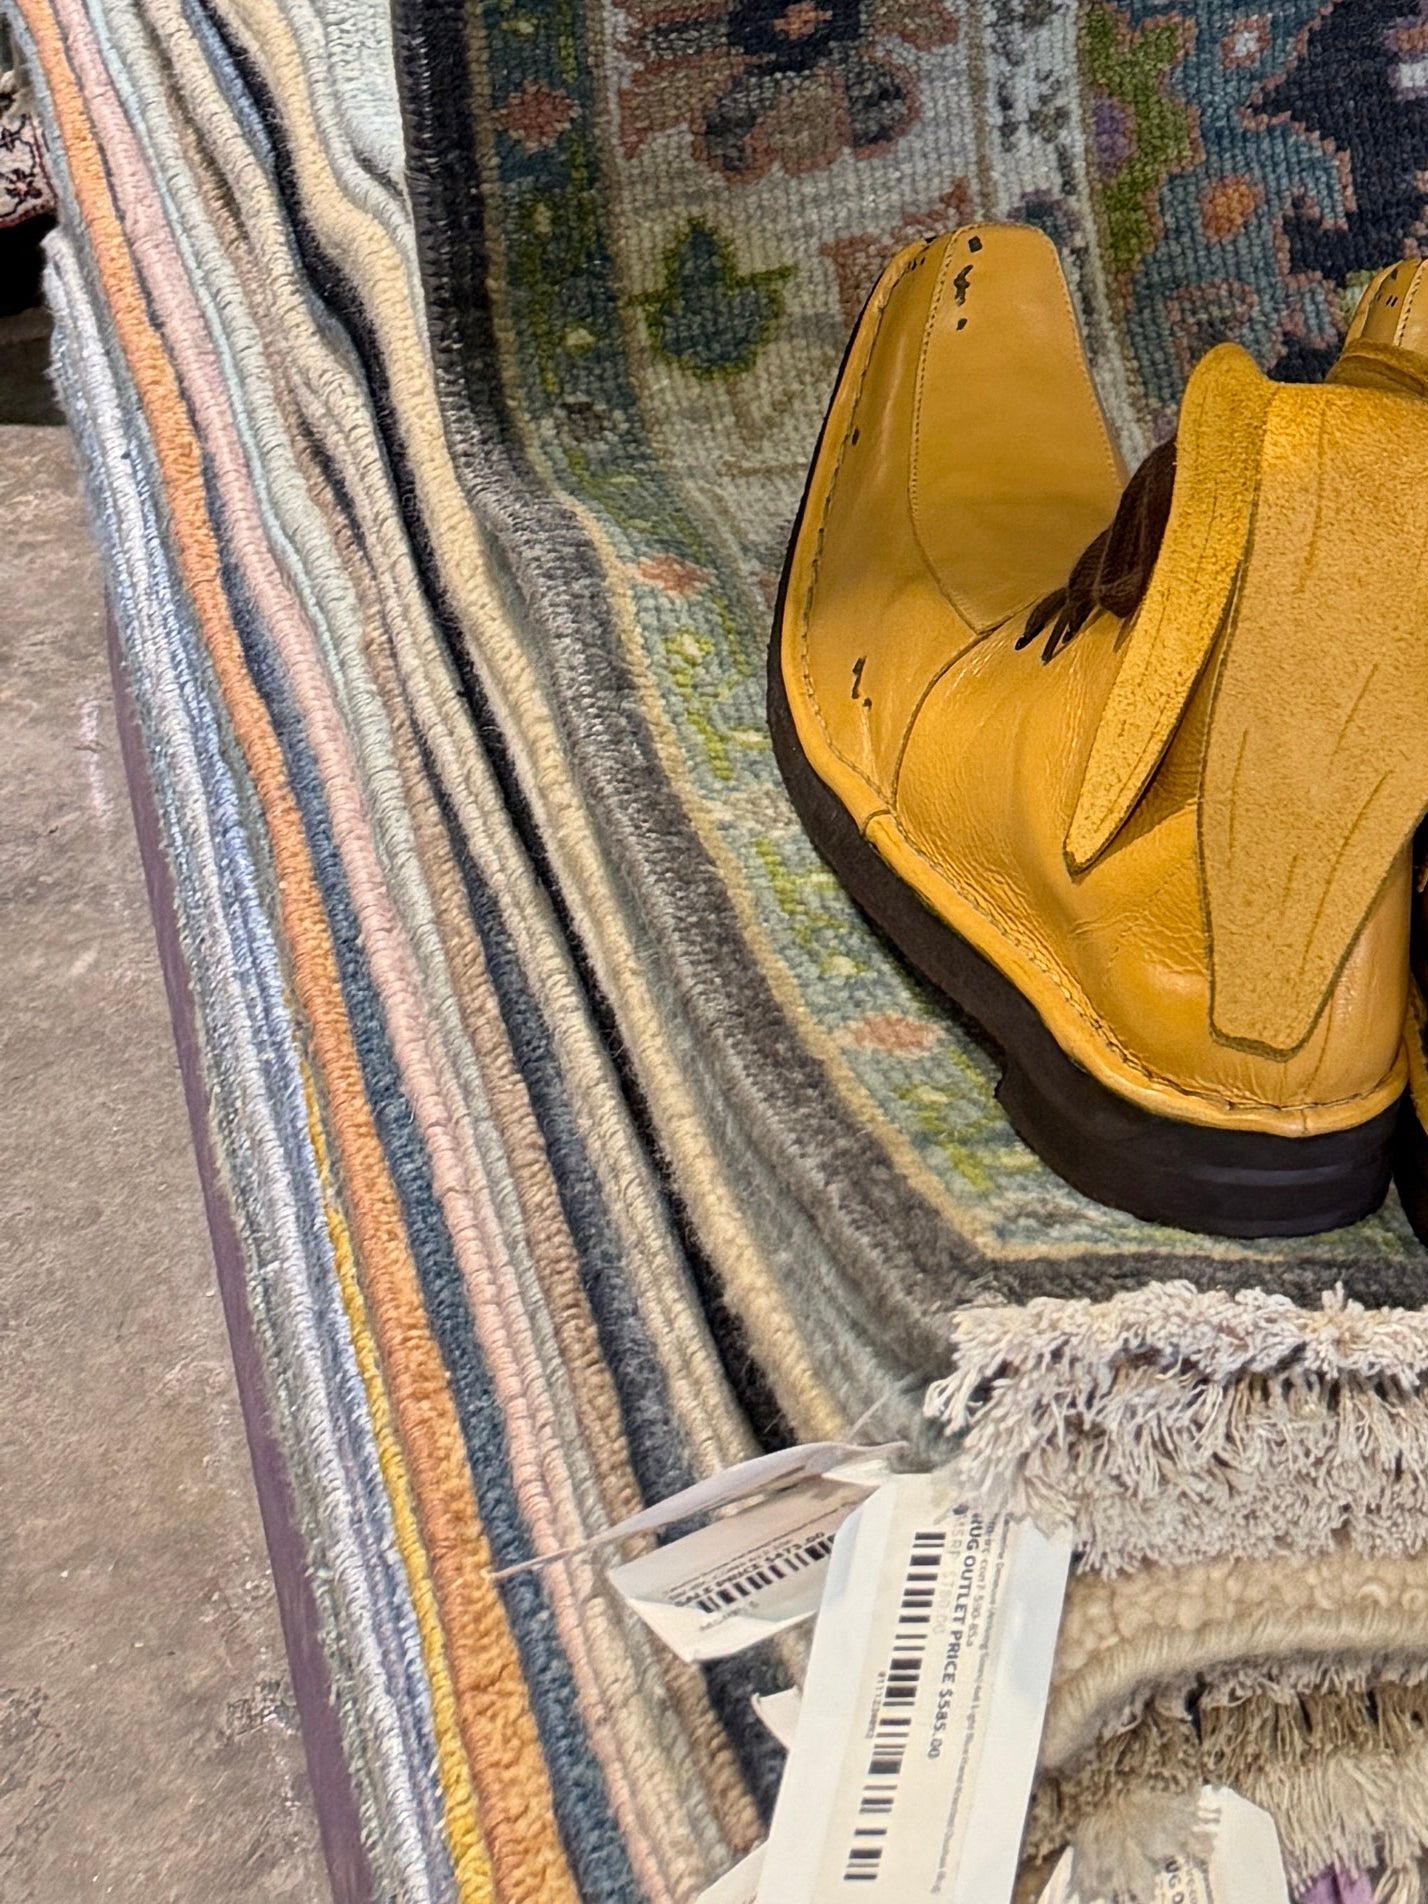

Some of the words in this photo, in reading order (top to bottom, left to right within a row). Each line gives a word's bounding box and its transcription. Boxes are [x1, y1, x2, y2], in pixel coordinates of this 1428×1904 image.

[952, 1555, 977, 1626] OUTLET
[942, 1630, 963, 1684] PRICE
[927, 1689, 954, 1760] $585.00
